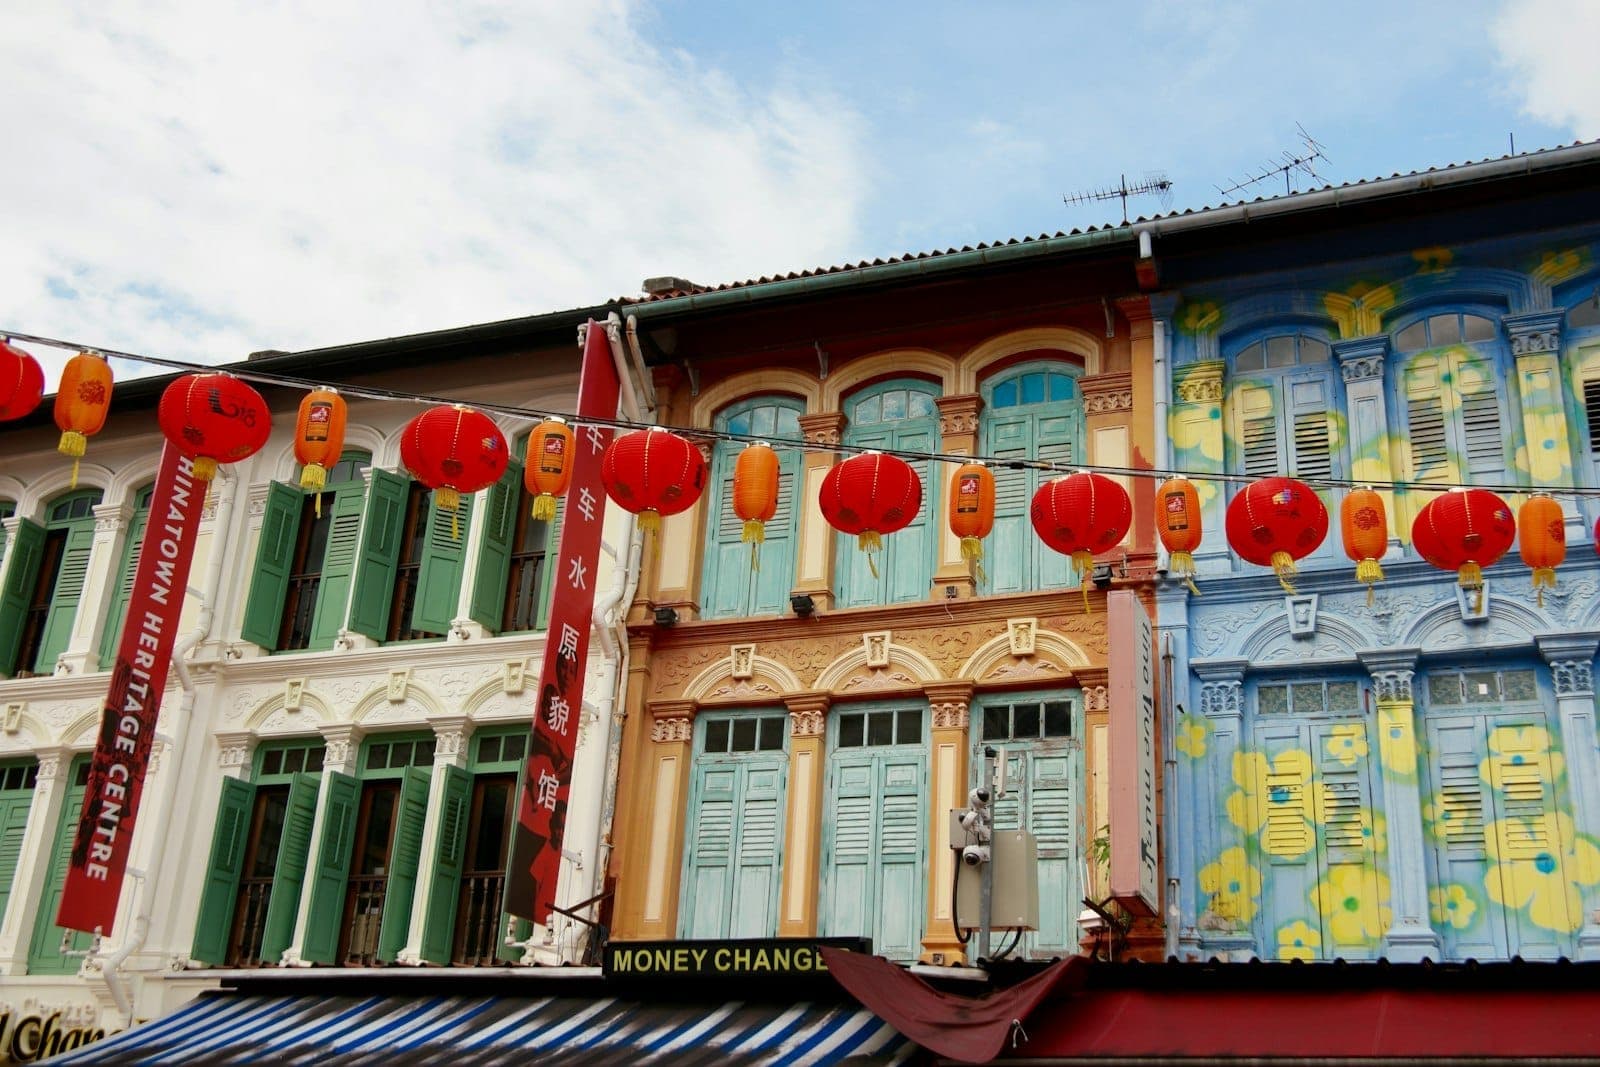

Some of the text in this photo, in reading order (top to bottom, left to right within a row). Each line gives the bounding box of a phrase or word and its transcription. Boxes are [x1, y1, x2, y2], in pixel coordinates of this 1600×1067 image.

[87, 455, 195, 883] HINATOWN HERITAGE CENTRE
[613, 948, 849, 972] MONEY CHANGE
